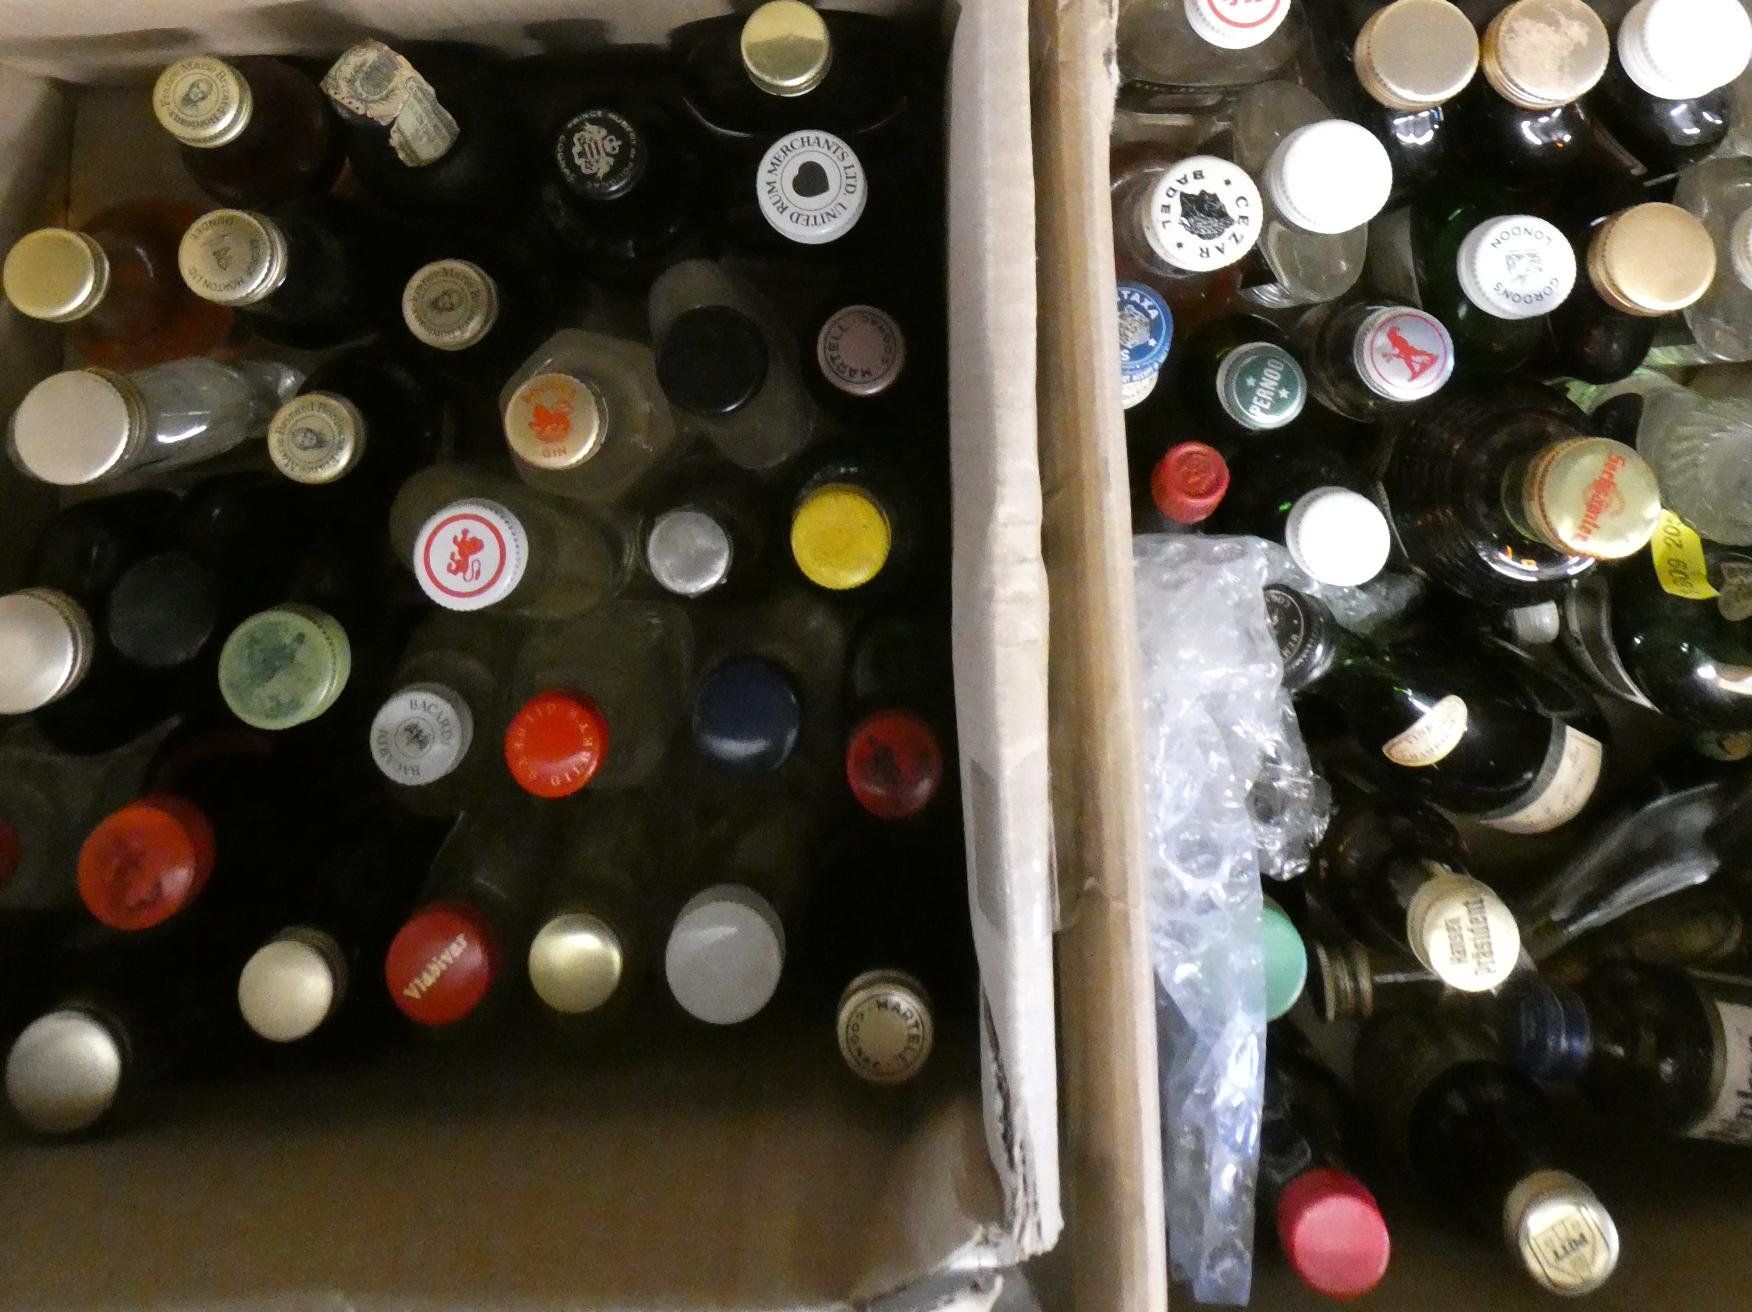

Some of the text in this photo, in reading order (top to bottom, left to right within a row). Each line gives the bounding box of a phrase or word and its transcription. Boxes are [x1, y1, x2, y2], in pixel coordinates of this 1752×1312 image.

[567, 110, 603, 128] PRINCE
[767, 136, 850, 176] MERCHANTS
[766, 180, 789, 215] RUM
[789, 202, 848, 226] UNITED
[1161, 170, 1205, 229] BADEL
[1200, 195, 1250, 258] CEZAR
[1491, 226, 1552, 248] LONDON
[1116, 290, 1159, 320] TAXA
[828, 324, 872, 378] MARTELL
[1249, 358, 1284, 417] PERNOD
[542, 447, 568, 459] GIN
[410, 698, 452, 745] BACARDI
[377, 729, 421, 776] BACARDI
[402, 933, 467, 1000] Vladivar
[876, 999, 921, 1064] MARTELL
